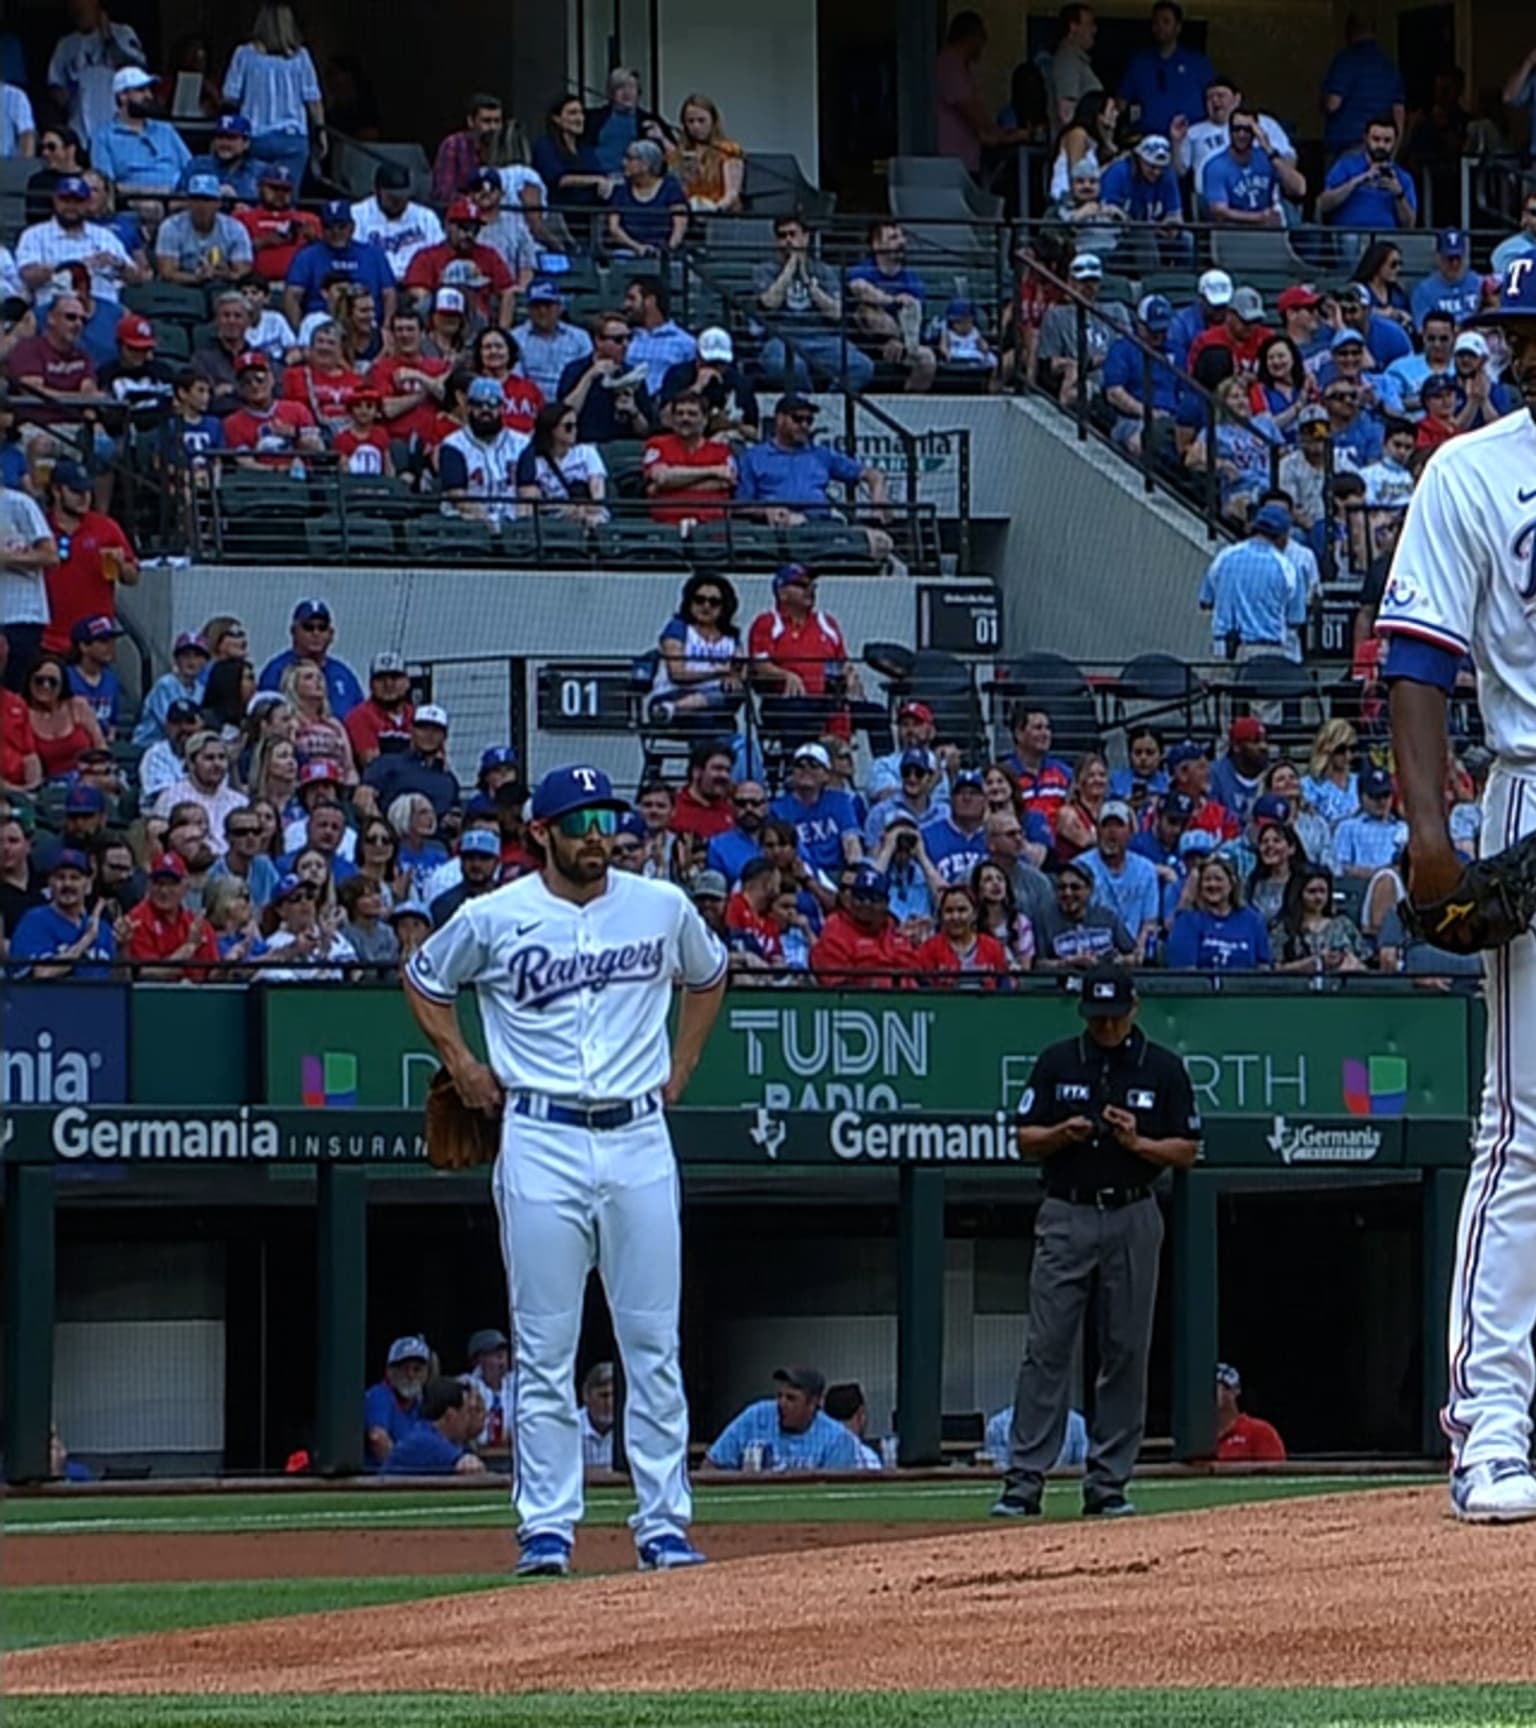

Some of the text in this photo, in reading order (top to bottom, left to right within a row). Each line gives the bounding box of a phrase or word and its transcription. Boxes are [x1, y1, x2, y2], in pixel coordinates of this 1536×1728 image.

[1505, 257, 1534, 297] T
[183, 431, 211, 452] T
[976, 617, 998, 645] 01
[1321, 623, 1343, 650] 01
[560, 680, 598, 717] 01
[572, 767, 598, 791] T
[795, 818, 839, 844] EXA
[508, 937, 668, 1004] Rangers
[730, 1009, 928, 1076] TUDN
[1182, 1055, 1306, 1108] RTH
[52, 1106, 429, 1158] Germania INSURAN
[1301, 1124, 1381, 1148] Germania
